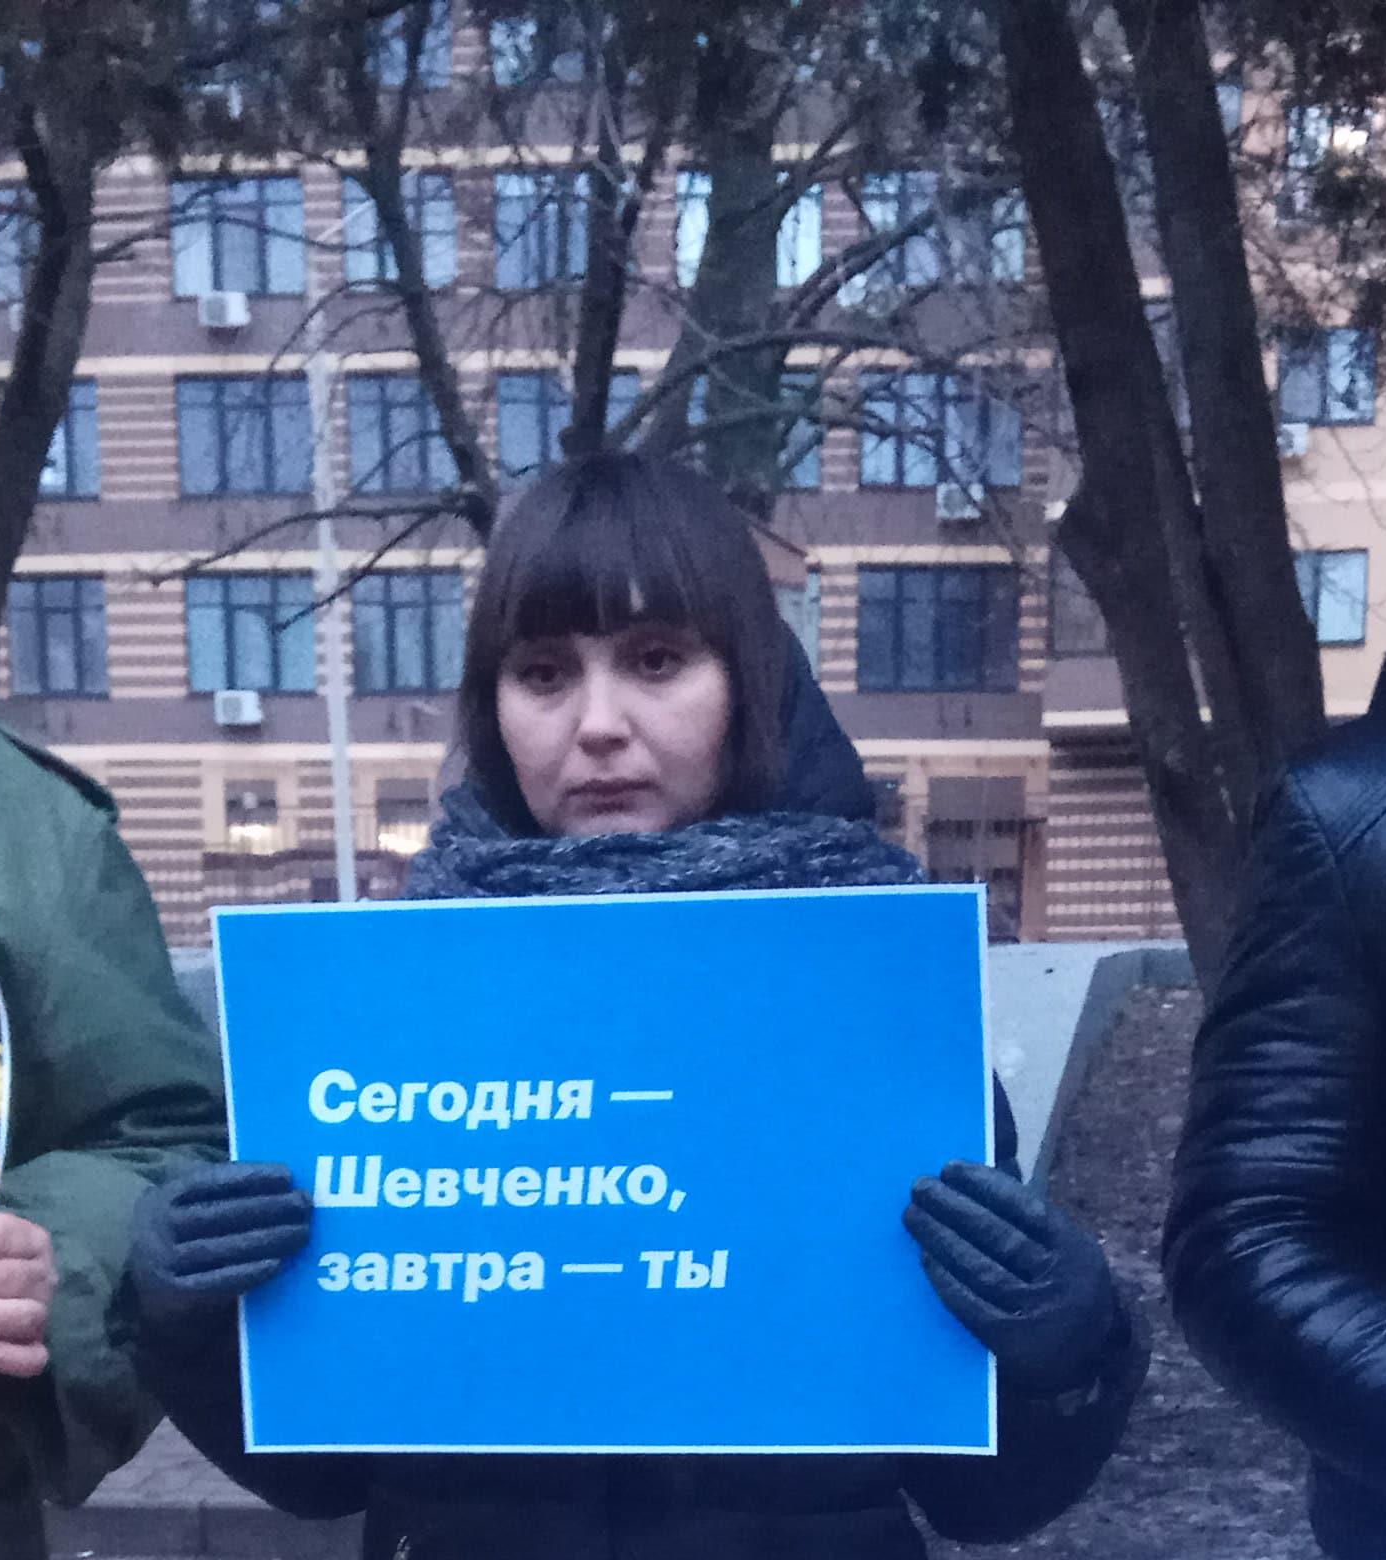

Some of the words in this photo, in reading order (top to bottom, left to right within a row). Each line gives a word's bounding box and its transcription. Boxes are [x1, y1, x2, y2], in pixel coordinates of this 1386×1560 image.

[308, 1068, 595, 1131] Сегодня
[313, 1154, 687, 1213] Шевченко,
[317, 1250, 545, 1303] завтра
[638, 1249, 730, 1290] ты
